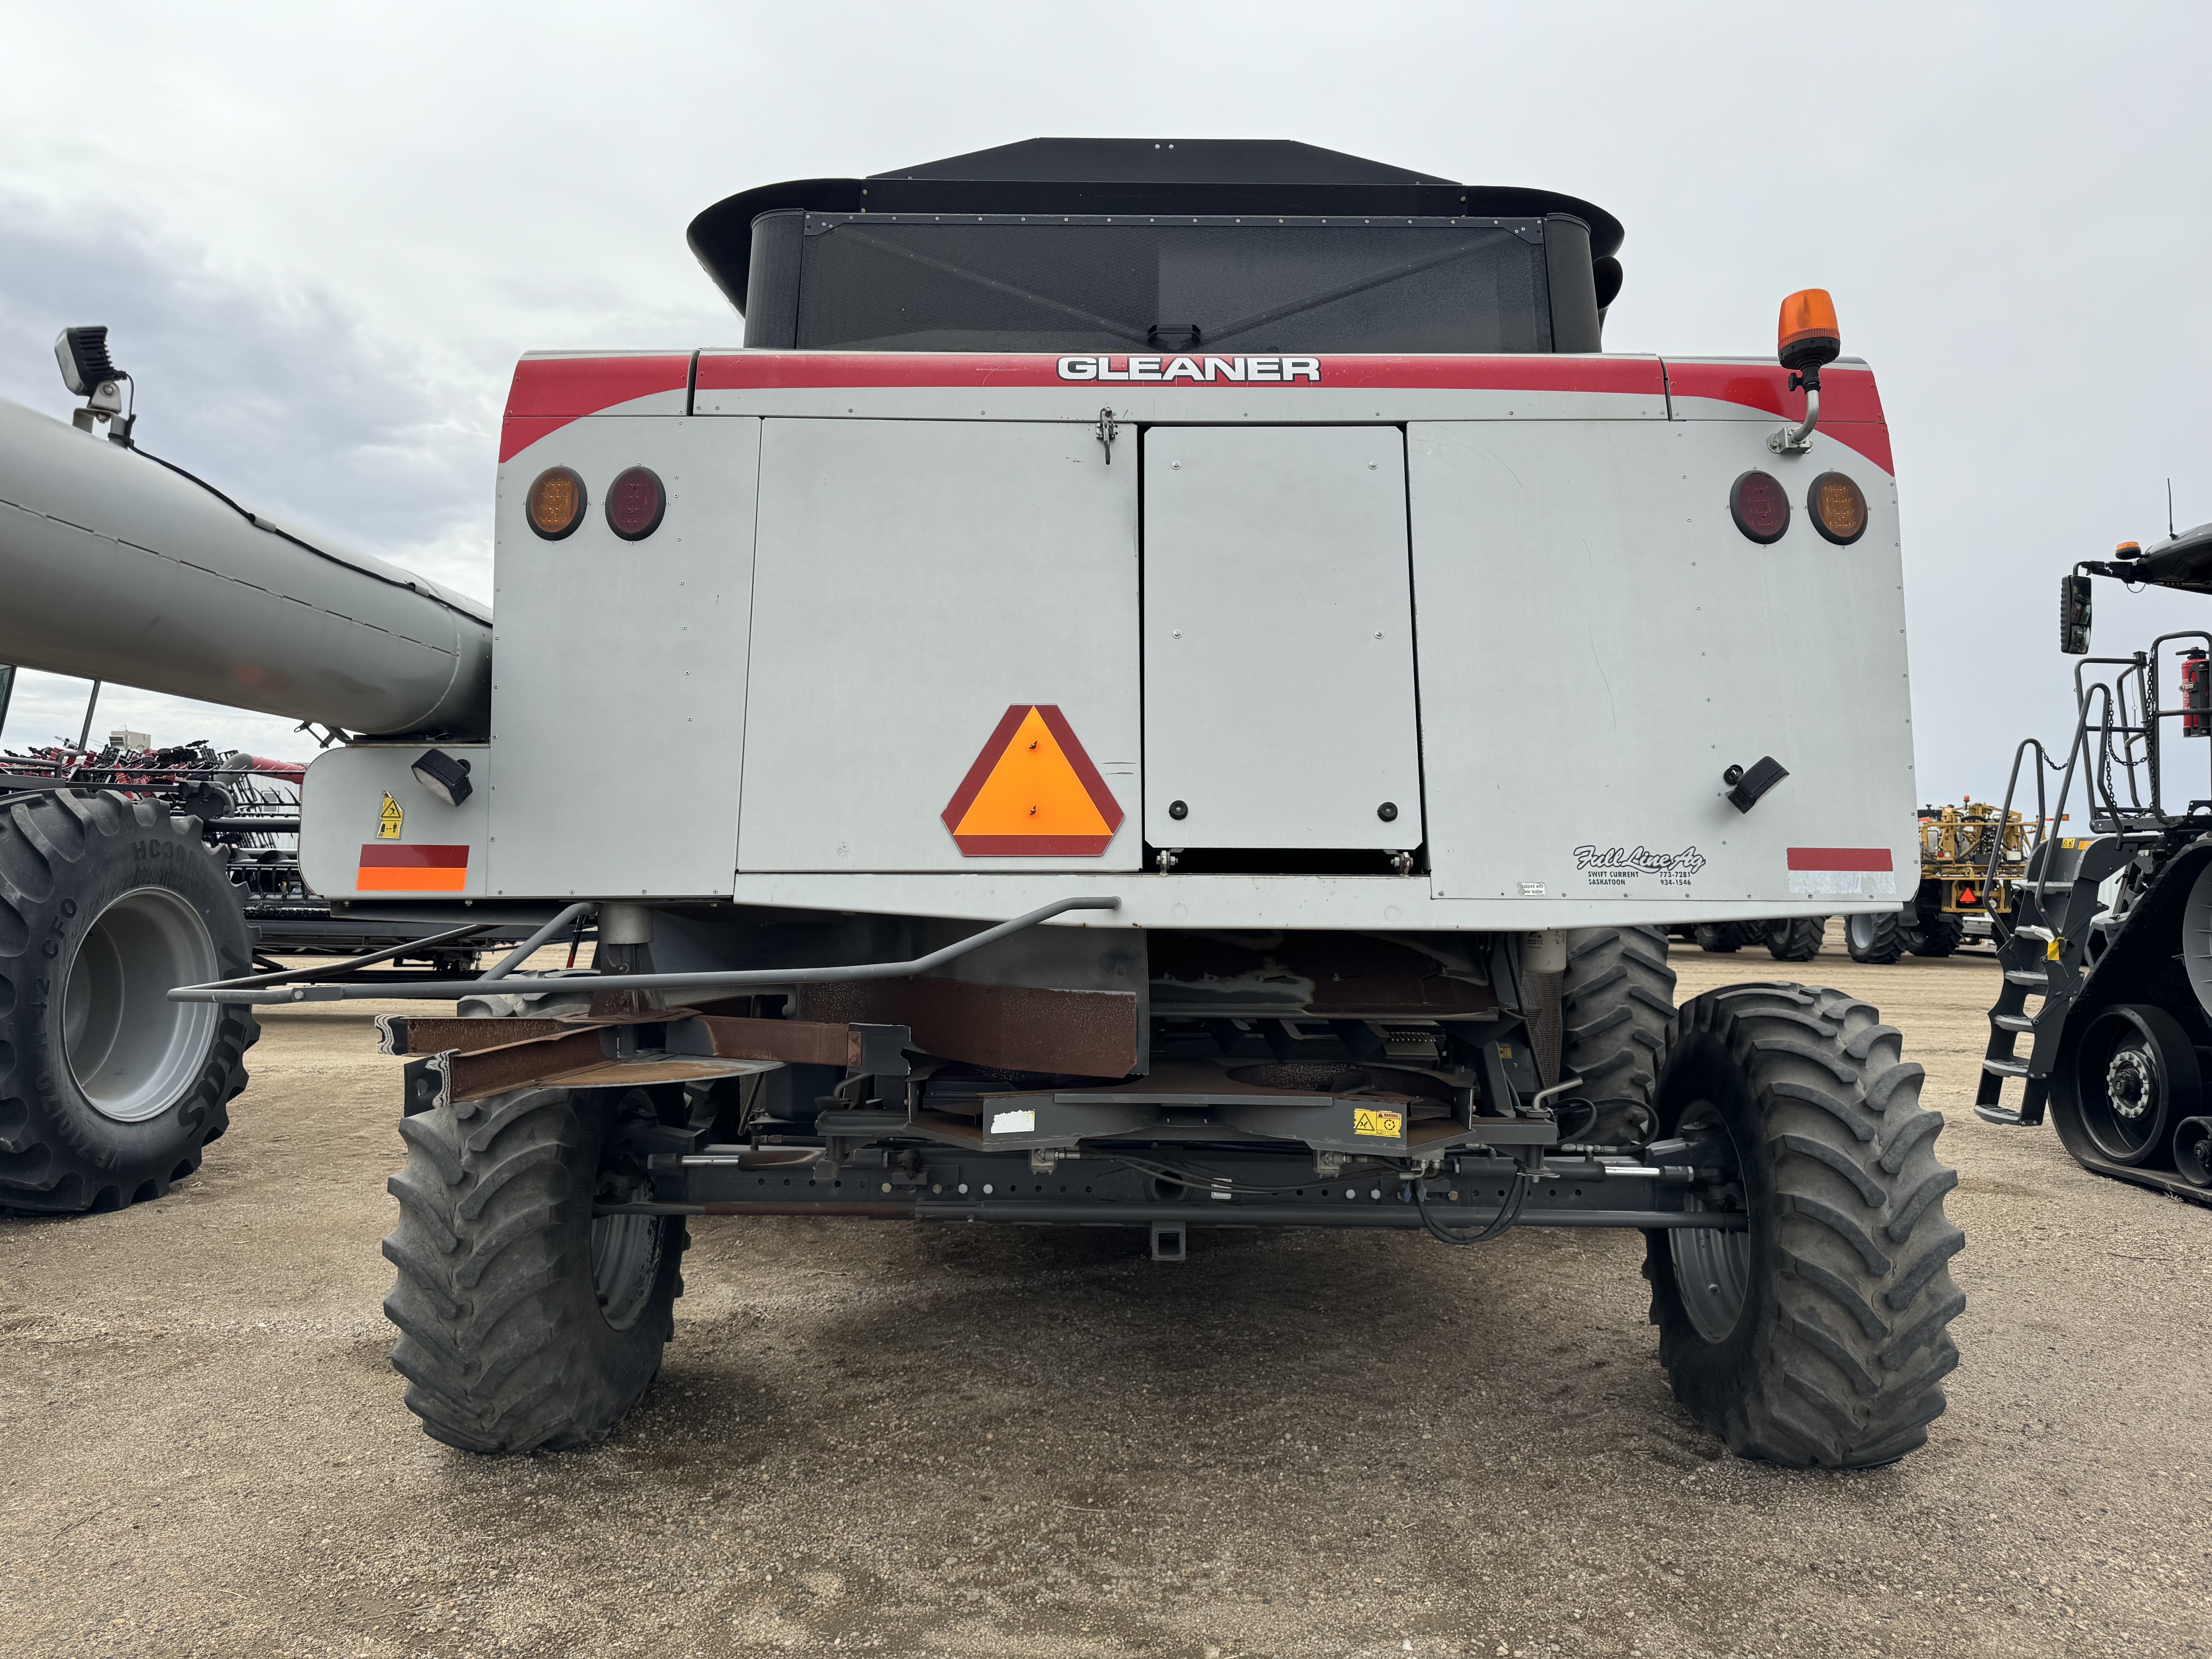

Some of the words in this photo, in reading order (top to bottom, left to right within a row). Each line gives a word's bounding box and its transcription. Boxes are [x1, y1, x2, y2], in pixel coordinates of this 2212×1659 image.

[1056, 357, 1321, 382] GLEANER
[131, 839, 207, 878] HC3000
[1573, 845, 1625, 870] Full
[1623, 846, 1672, 874] Line
[1668, 846, 1706, 874] Ag
[42, 897, 77, 960] CFO
